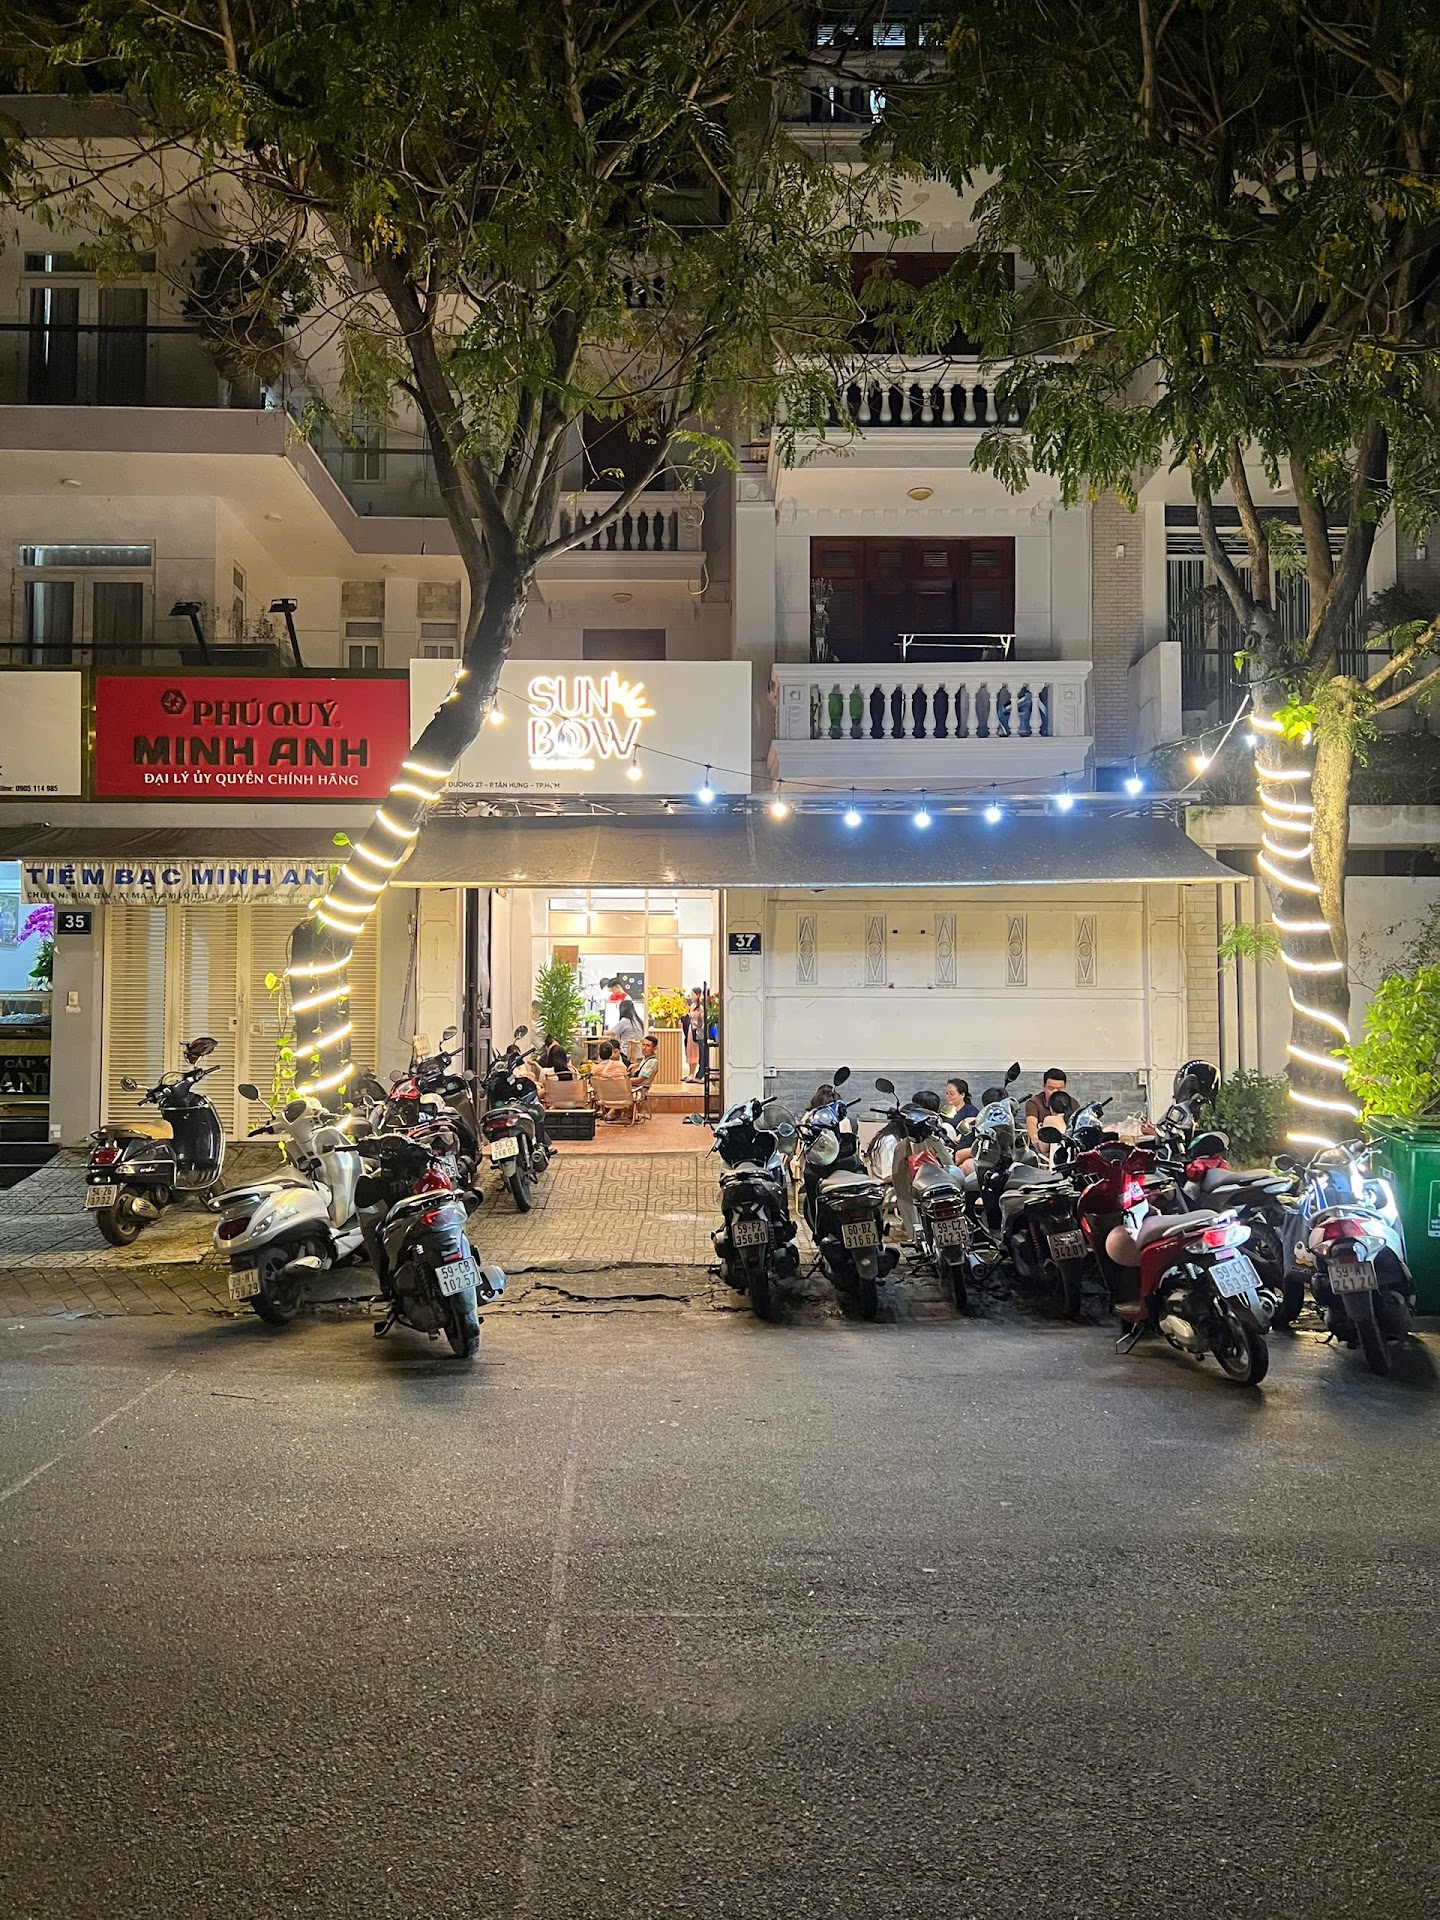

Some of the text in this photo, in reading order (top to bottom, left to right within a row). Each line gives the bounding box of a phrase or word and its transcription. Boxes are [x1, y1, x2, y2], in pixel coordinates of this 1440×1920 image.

[528, 675, 611, 717] SUN
[192, 697, 338, 727] PHÚ QUÝ
[133, 735, 368, 767] MINH ANH
[528, 717, 642, 760] BOW
[144, 769, 359, 787] ĐẠI LÝ ỦY QUYỀN CHÍNH HÃNG
[26, 864, 105, 890] TIỆM
[114, 868, 181, 890] BẠC
[191, 868, 271, 885] MINH
[64, 914, 85, 929] 35
[735, 933, 757, 948] 37
[441, 1260, 471, 1279] 59-CB
